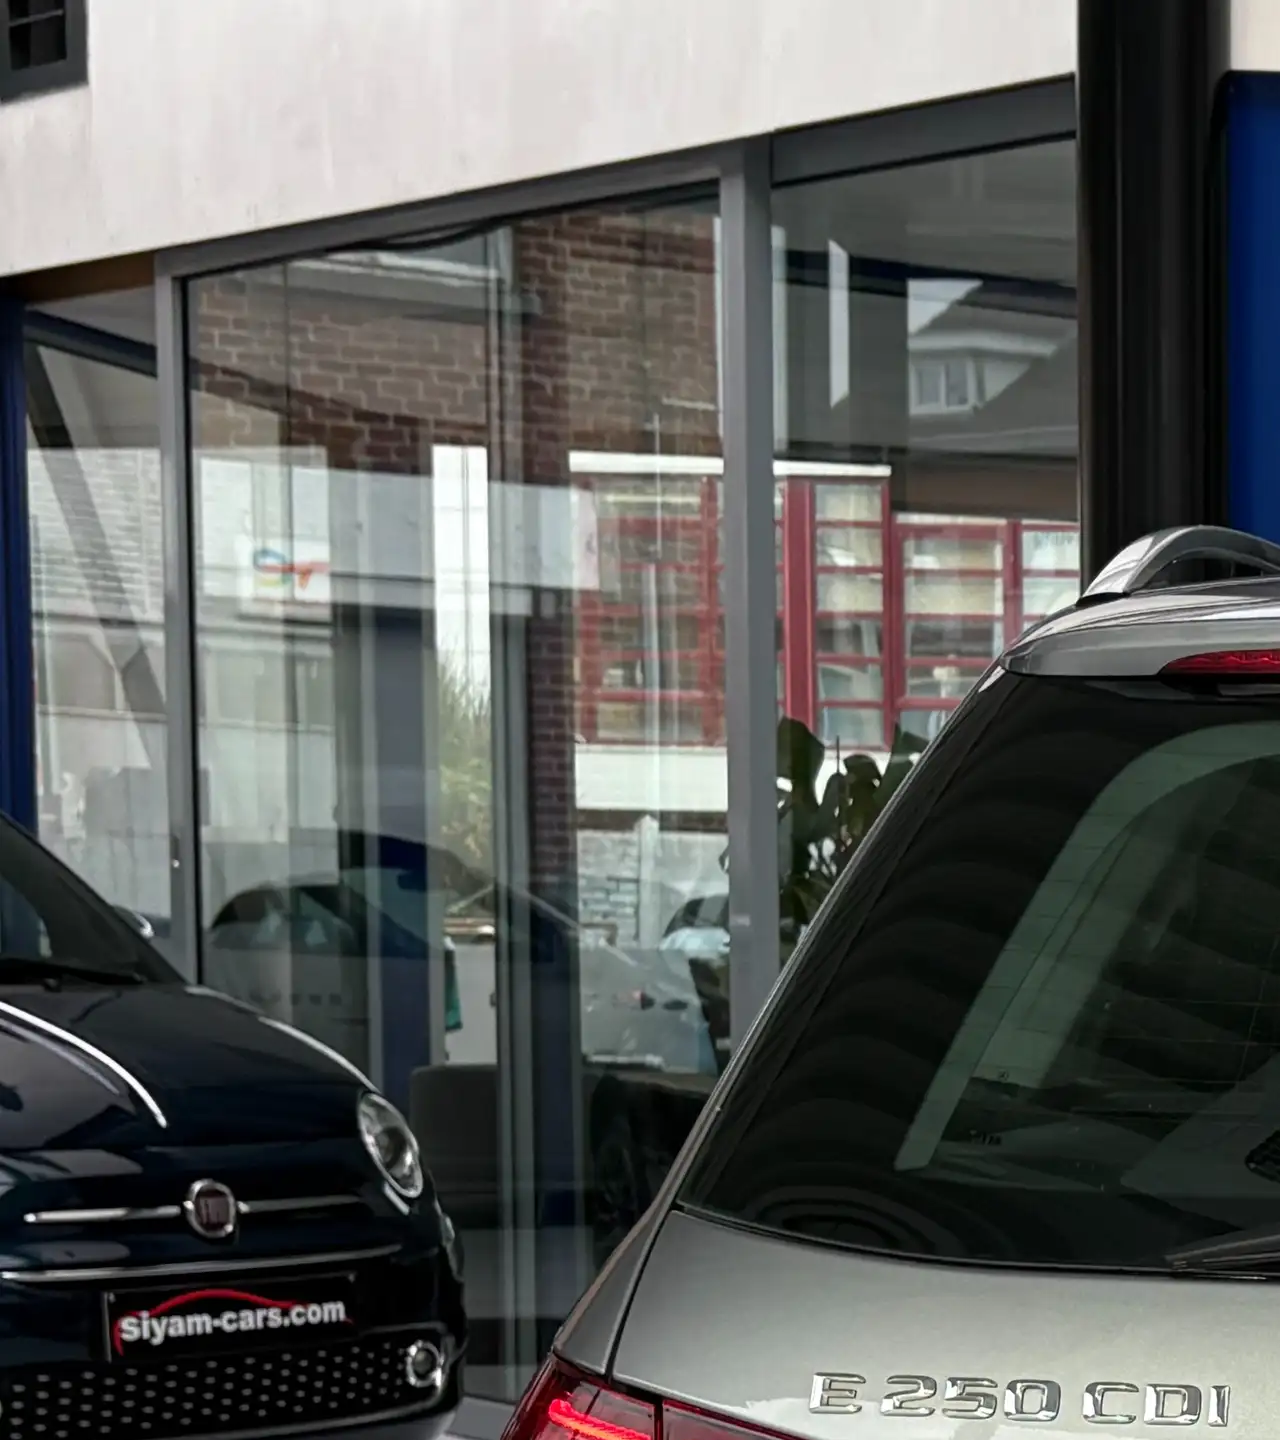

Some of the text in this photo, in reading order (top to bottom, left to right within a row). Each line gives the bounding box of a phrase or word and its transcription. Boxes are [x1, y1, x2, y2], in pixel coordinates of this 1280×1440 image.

[119, 1301, 345, 1345] siyam-cars.com
[808, 1372, 1231, 1427] E 250 CDI
